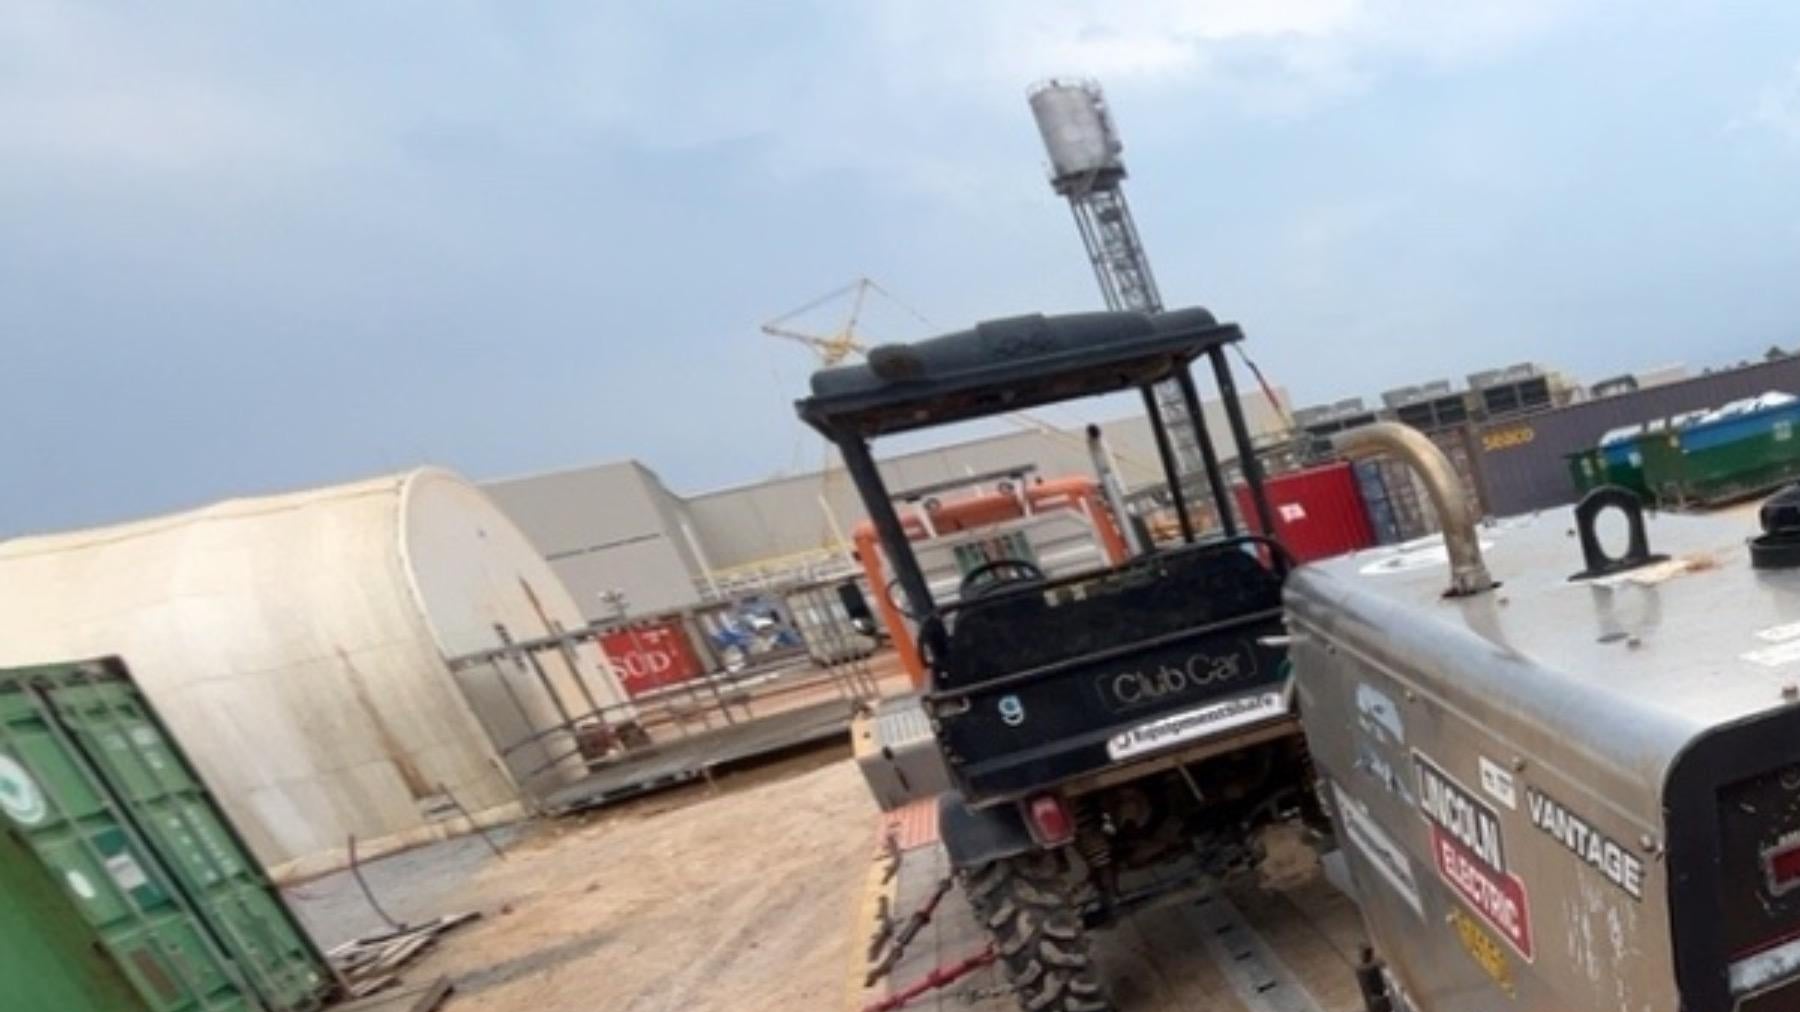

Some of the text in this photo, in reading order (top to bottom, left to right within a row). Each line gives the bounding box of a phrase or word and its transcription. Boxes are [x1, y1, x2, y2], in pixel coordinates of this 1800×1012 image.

[1112, 653, 1241, 701] Club Car
[1414, 762, 1503, 872] LINCOLN
[1526, 787, 1643, 898] VANTAGE
[1440, 840, 1523, 941] ELECTRIC
